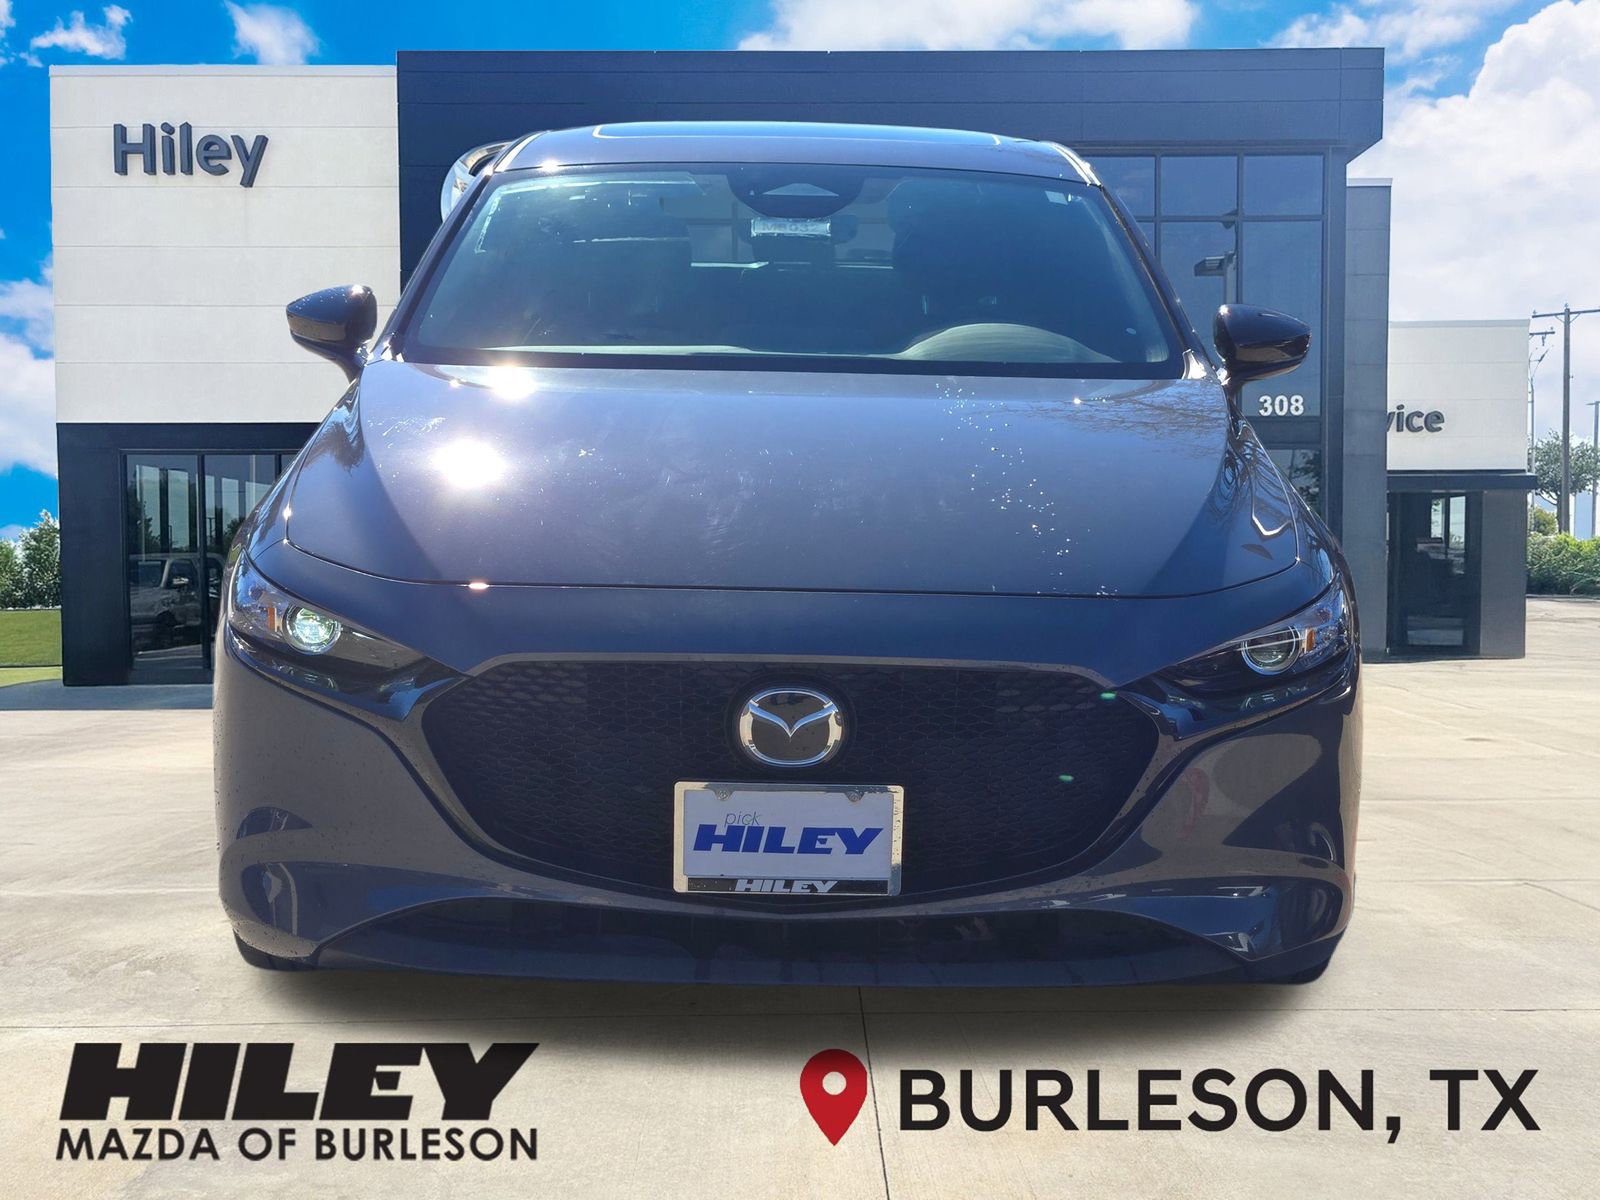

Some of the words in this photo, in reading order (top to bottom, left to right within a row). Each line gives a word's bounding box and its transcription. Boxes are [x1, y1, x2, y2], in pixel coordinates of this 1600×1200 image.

[113, 122, 269, 187] Hiley
[1258, 395, 1305, 417] 308
[724, 811, 761, 827] pick
[693, 824, 883, 855] HILEY
[734, 879, 839, 893] HILEY
